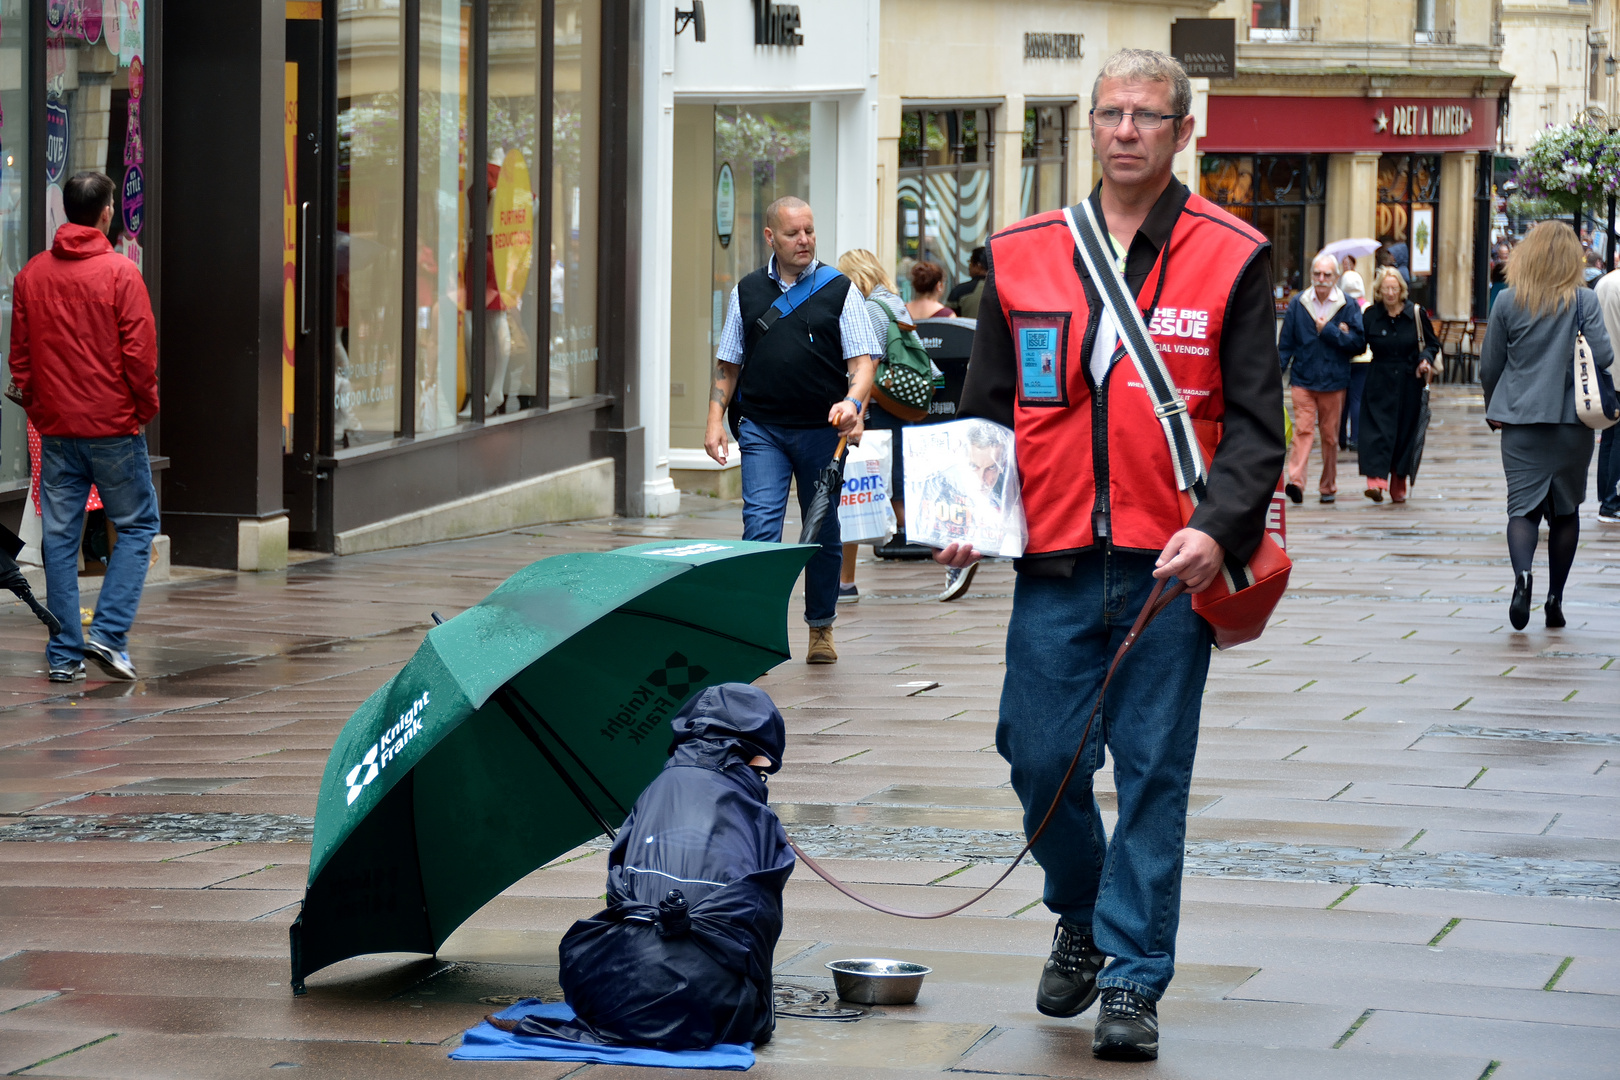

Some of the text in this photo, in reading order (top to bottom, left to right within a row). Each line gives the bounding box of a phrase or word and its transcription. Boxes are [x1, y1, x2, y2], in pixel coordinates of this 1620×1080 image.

[1184, 53, 1226, 63] BANANA
[1393, 105, 1464, 135] PRET A MANGER
[126, 177, 141, 197] STYLE
[500, 209, 526, 226] FURTHER
[495, 230, 531, 249] REDUCTIONS
[1154, 307, 1208, 321] HE BIG
[1028, 333, 1047, 341] THE BIG
[1149, 318, 1208, 339] SSUE
[1156, 343, 1210, 356] CIAL VENDOR
[334, 384, 395, 410] ONSOON.CO.UK
[1182, 388, 1210, 396] MAGAZINE
[380, 690, 430, 752] Knight
[380, 717, 424, 769] Frank
